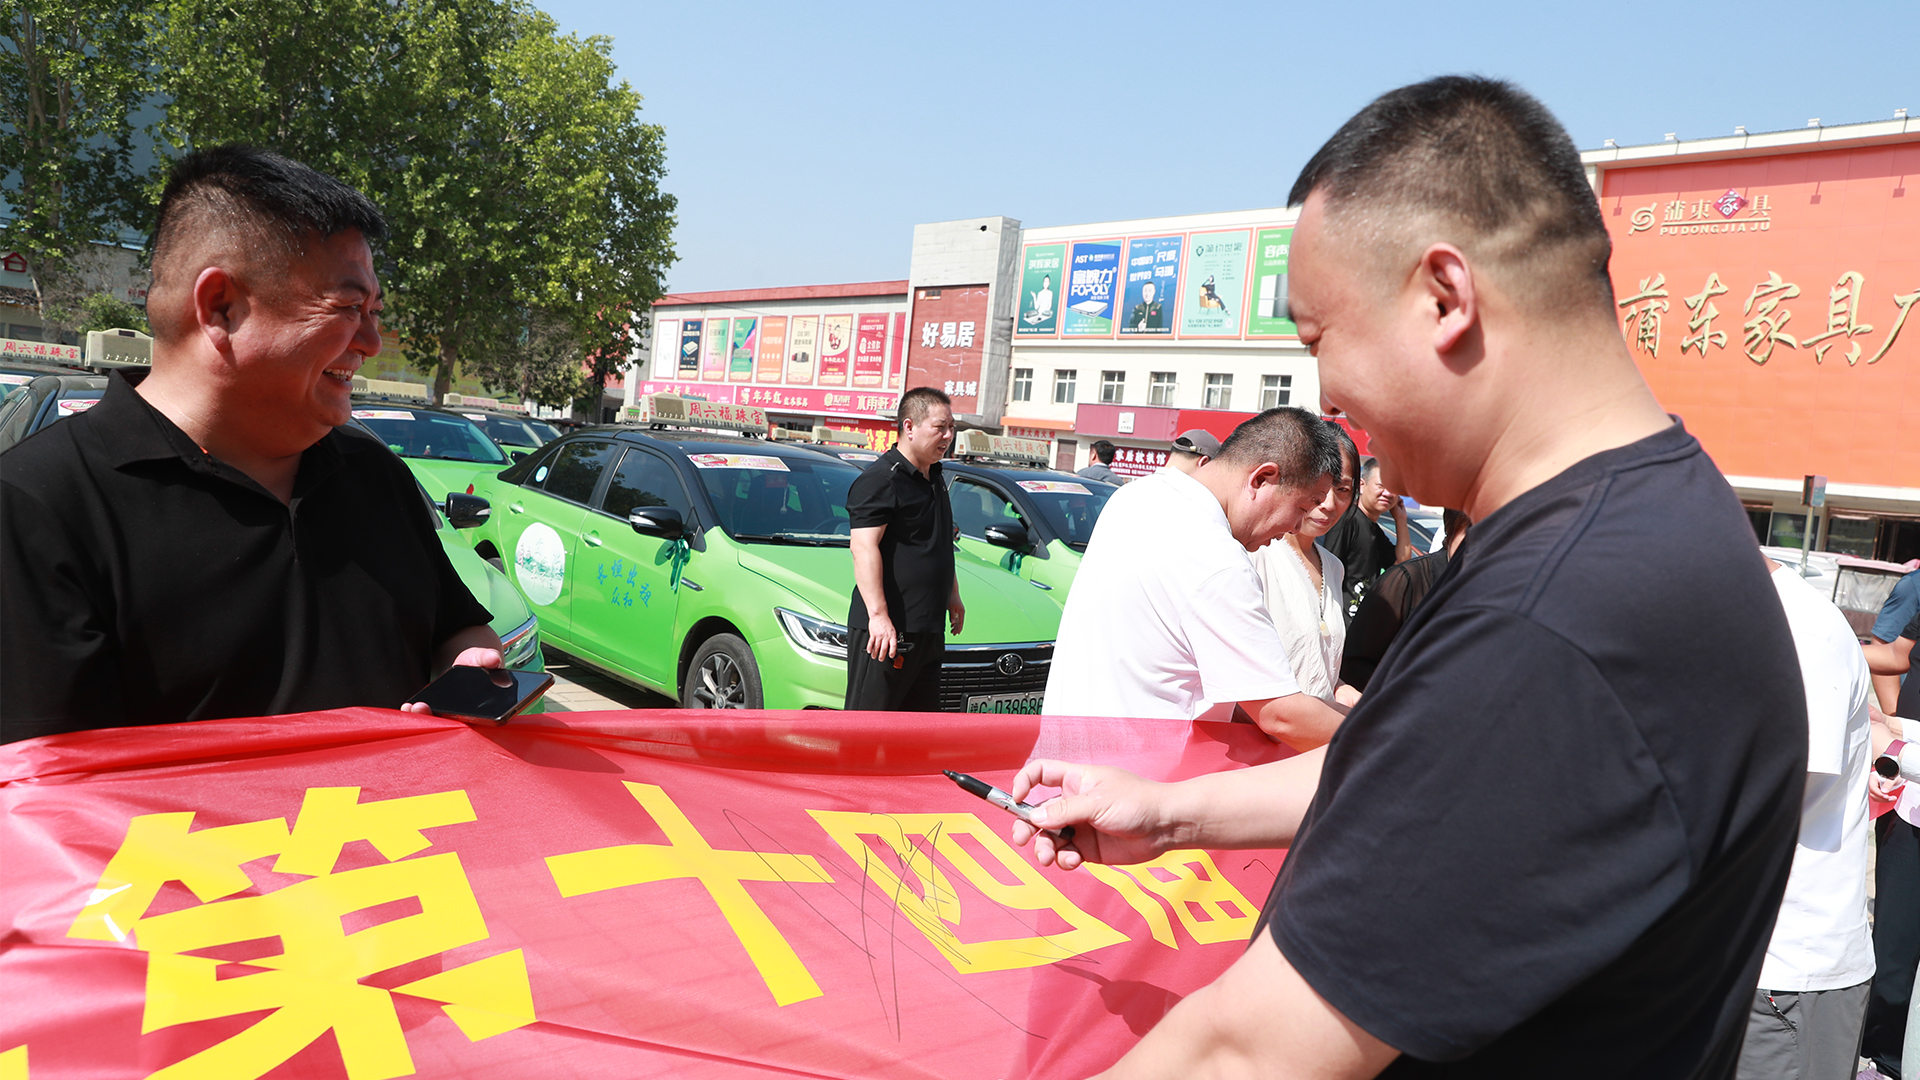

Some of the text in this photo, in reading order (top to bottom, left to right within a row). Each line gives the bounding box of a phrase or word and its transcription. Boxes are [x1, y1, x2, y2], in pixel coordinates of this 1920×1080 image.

[1075, 255, 1089, 264] AST
[921, 321, 976, 349] 好易居
[3, 341, 78, 358] 周六福珠宝
[944, 380, 978, 397] 家具城
[688, 401, 764, 426] 周六福珠宝
[993, 437, 1046, 456] 周六福珠宝
